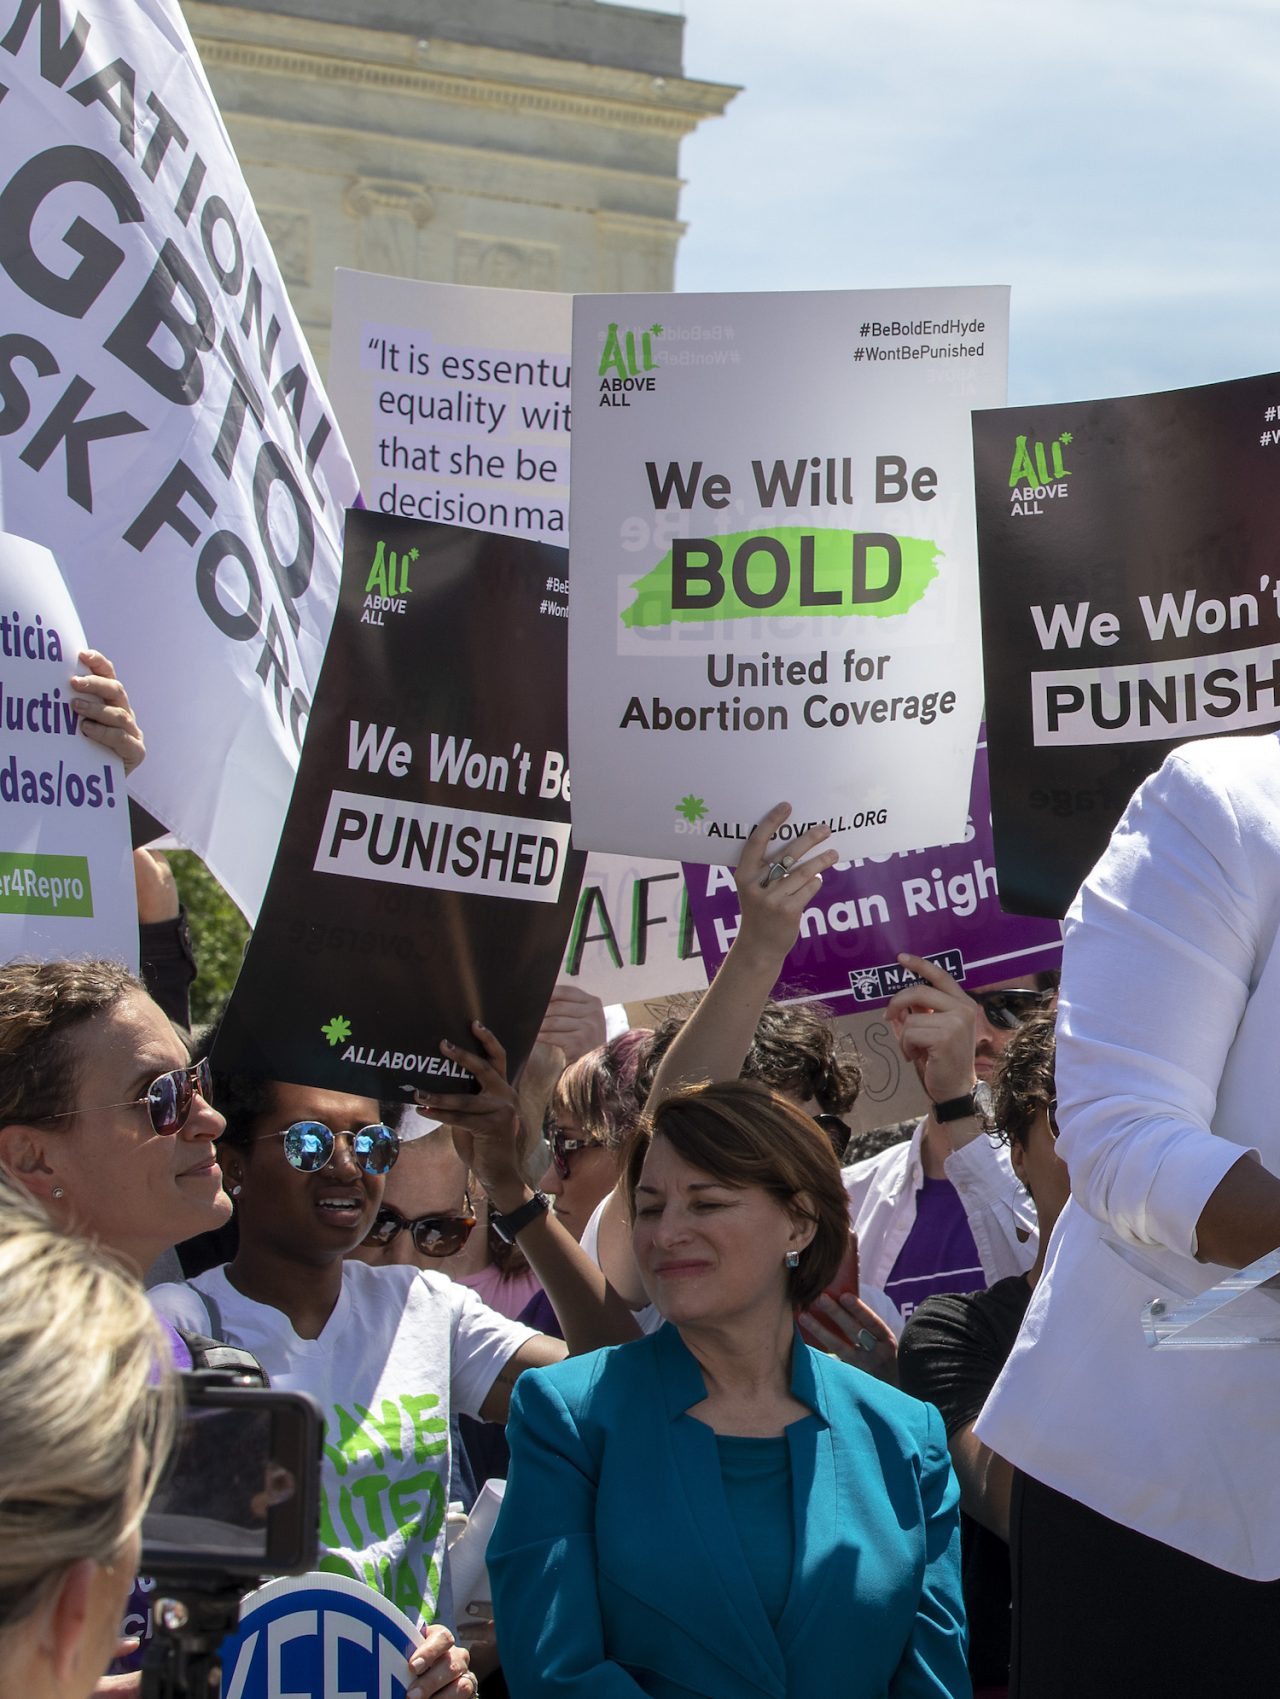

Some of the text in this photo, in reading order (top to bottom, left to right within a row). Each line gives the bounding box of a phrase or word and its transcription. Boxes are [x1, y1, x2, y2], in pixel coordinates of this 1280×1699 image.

[860, 319, 985, 338] #BeBoldEndHyde
[409, 344, 429, 376] is
[854, 343, 984, 362] #WontBePunished
[599, 377, 656, 391] ABOVE
[599, 393, 631, 407] ALL
[378, 391, 506, 433] equality
[378, 436, 557, 482] that she be
[645, 455, 938, 510] We Will Be
[1010, 484, 1069, 501] ABOVE
[1010, 500, 1044, 516] ALL
[670, 532, 903, 609] BOLD
[360, 610, 385, 626] ALL
[363, 594, 408, 613] ABOVE
[1030, 601, 1120, 651] We
[708, 649, 891, 687] United for
[619, 689, 956, 731] Abortion Coverage
[347, 719, 412, 777] We
[429, 732, 531, 796] Won't
[328, 808, 559, 887] PUNISHED
